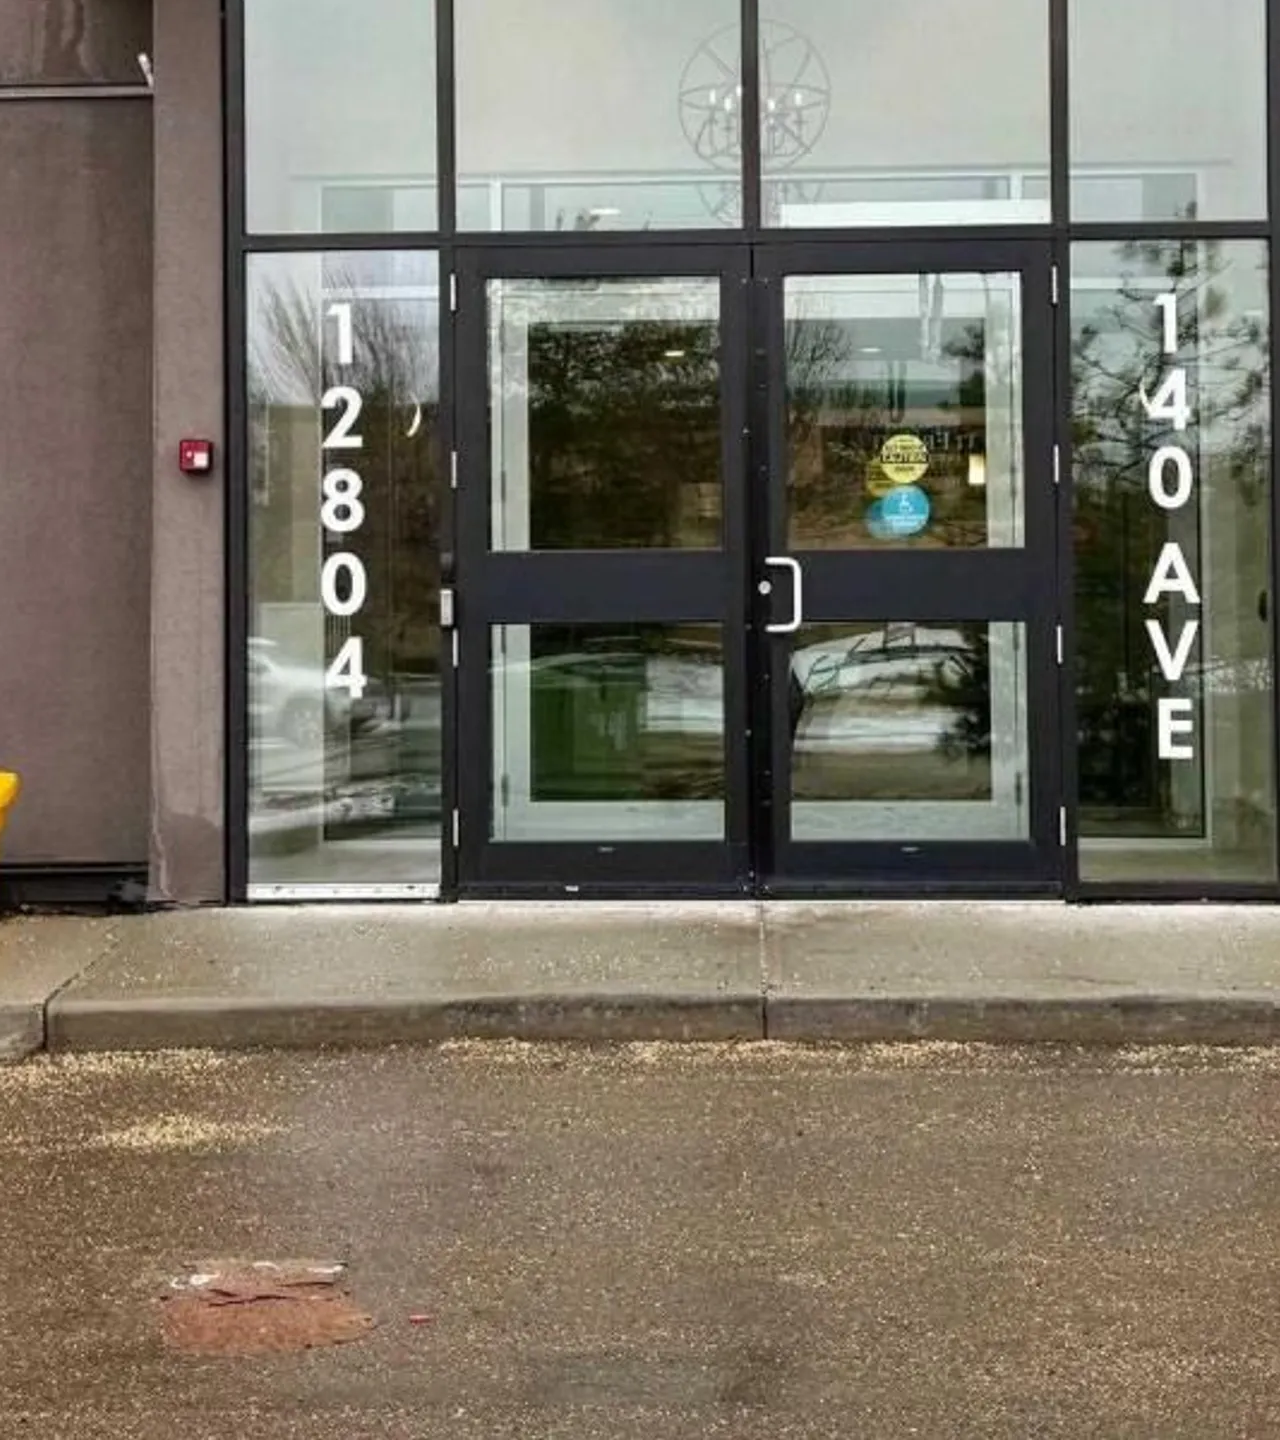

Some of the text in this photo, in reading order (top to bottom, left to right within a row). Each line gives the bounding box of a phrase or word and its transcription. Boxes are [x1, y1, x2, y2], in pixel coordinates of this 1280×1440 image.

[321, 303, 367, 698] 12804
[1143, 293, 1201, 759] 140 AVE
